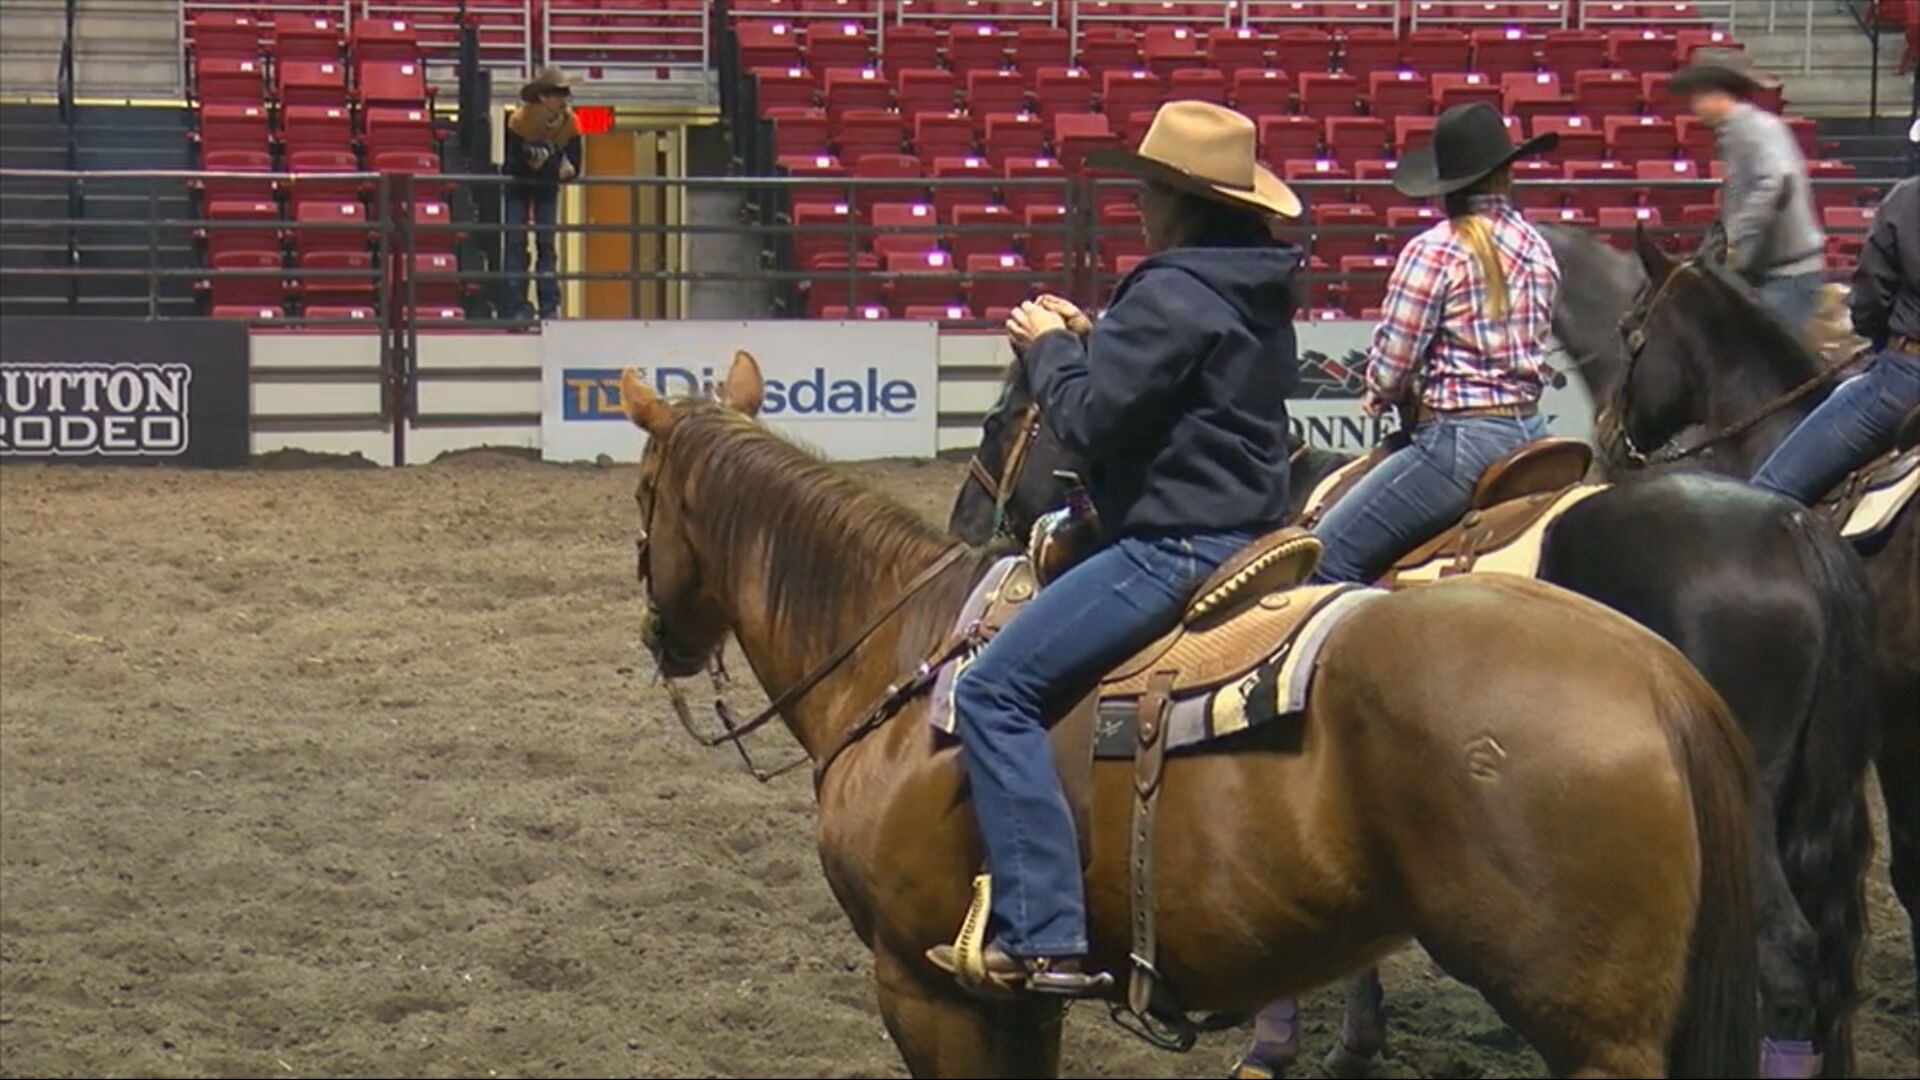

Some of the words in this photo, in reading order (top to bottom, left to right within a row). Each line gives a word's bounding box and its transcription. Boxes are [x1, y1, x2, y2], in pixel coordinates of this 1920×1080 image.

[0, 371, 183, 413] UTTON
[655, 367, 917, 413] Disdale
[0, 416, 182, 447] ODEO
